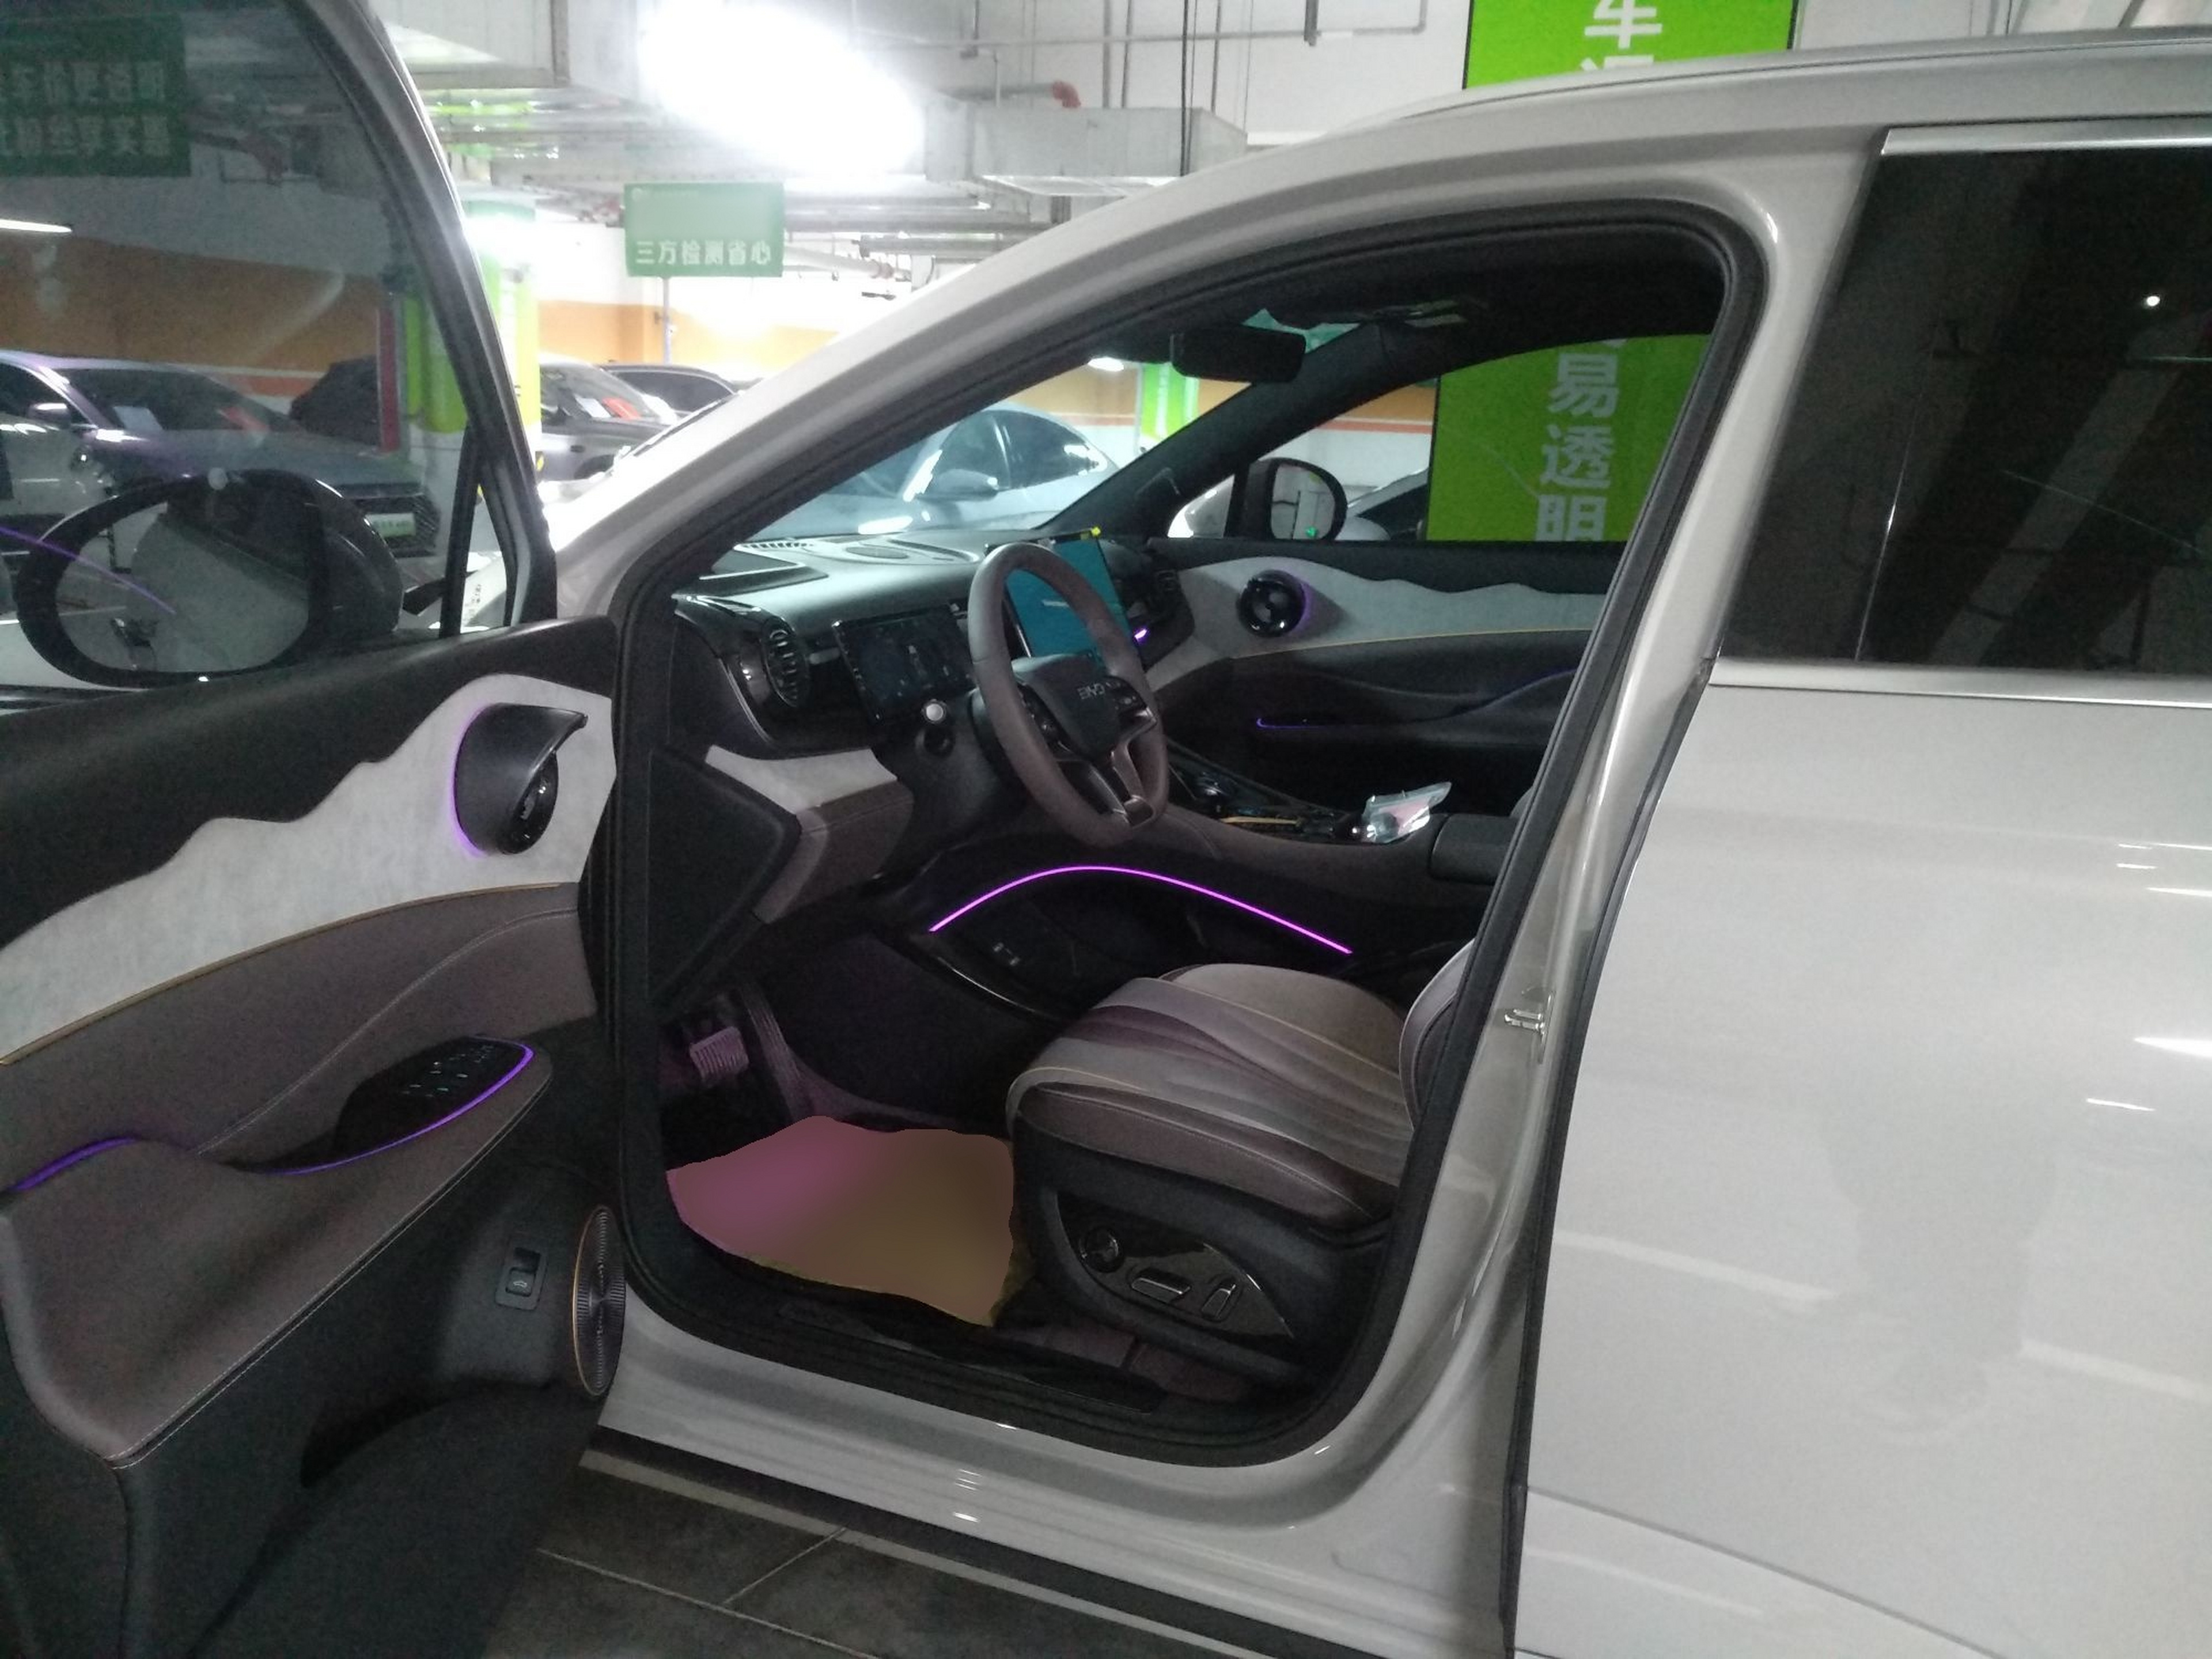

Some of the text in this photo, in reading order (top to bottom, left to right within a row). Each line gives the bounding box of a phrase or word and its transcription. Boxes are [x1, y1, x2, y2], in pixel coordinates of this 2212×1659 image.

[1580, 0, 1662, 70] 车
[636, 239, 771, 266] 三方检测省心
[1535, 339, 1628, 541] 易透明
